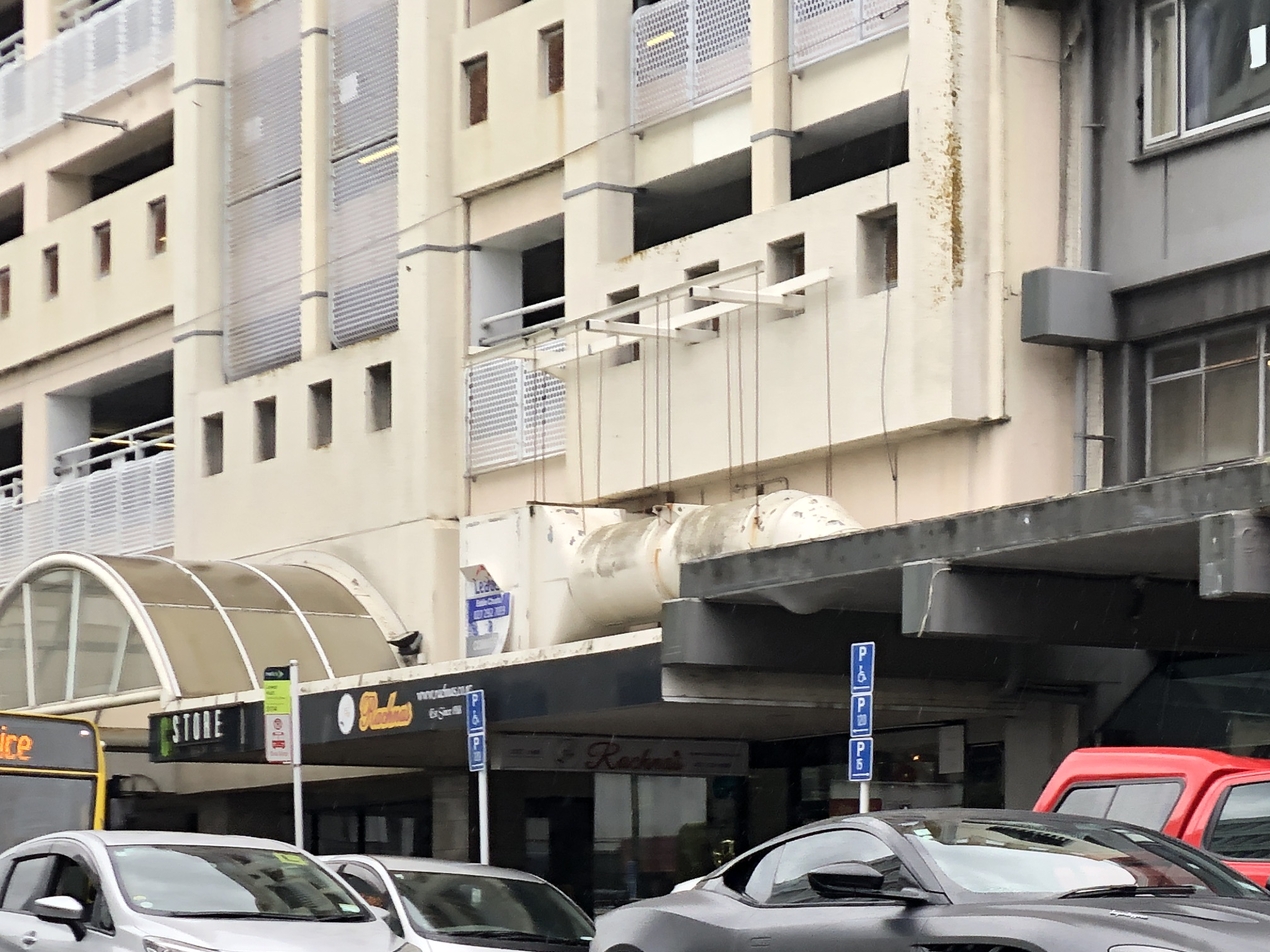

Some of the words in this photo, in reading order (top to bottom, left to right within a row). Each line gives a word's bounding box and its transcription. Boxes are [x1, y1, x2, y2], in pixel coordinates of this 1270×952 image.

[858, 646, 867, 661] P
[471, 693, 479, 707] P
[857, 697, 866, 712] P
[172, 709, 224, 744] STORE
[473, 737, 480, 750] P
[856, 741, 865, 756] P
